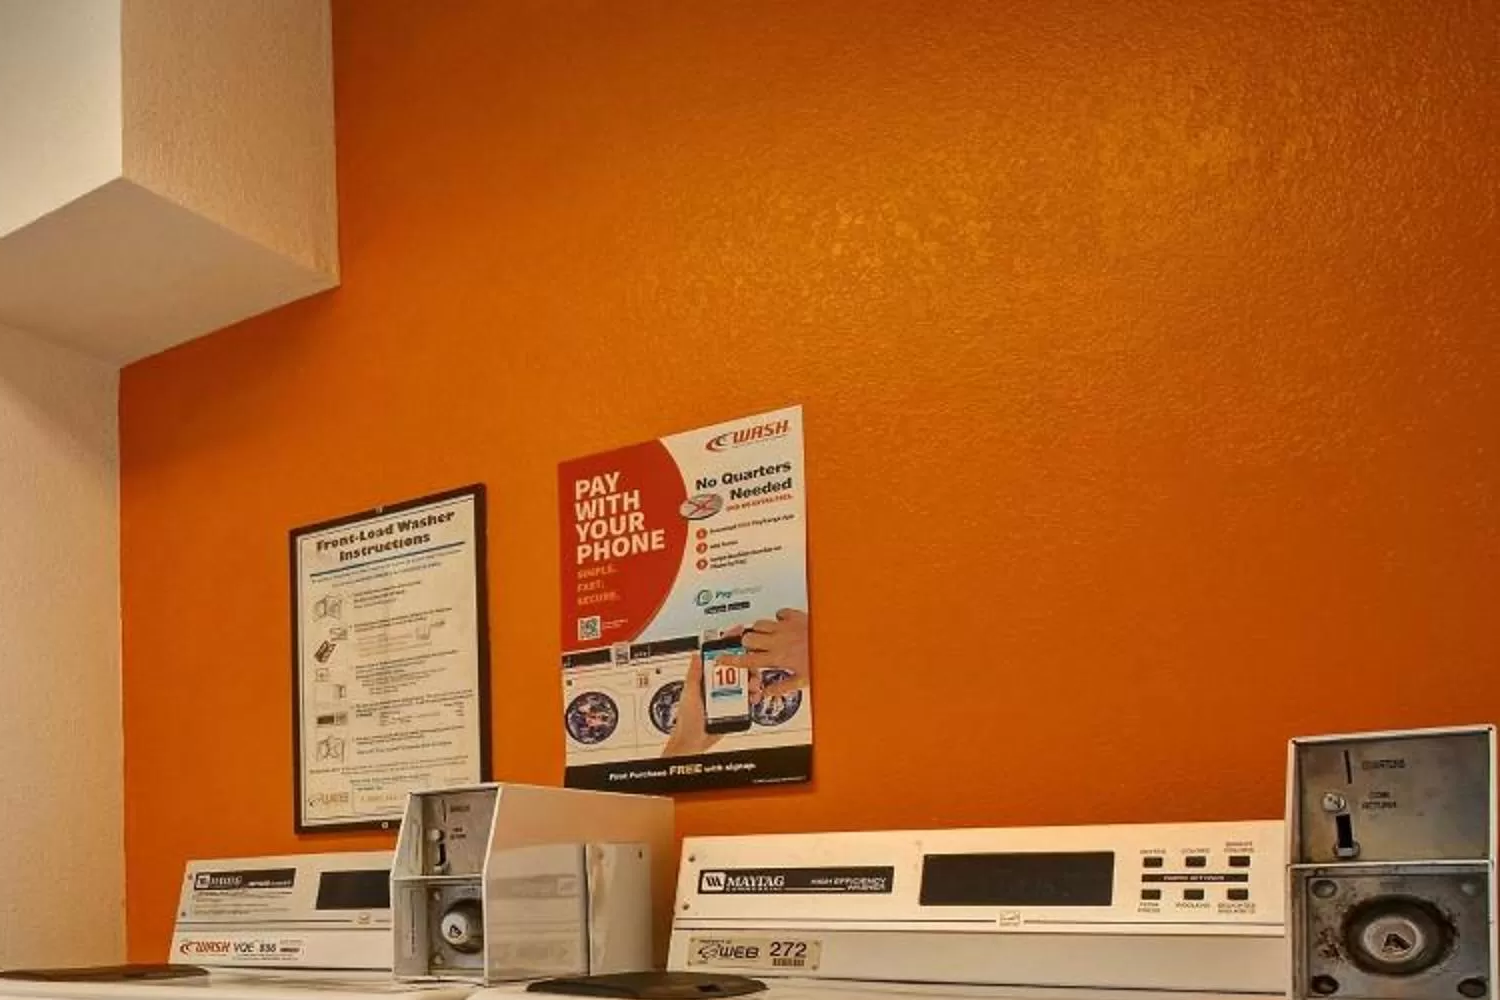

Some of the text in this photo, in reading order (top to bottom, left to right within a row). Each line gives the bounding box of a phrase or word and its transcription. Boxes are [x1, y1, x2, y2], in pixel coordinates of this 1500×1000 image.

[733, 420, 789, 443] WASH
[575, 472, 620, 500] PAY
[696, 462, 791, 491] No Quarters
[730, 477, 792, 500] Needed
[575, 490, 640, 521] WITH
[316, 511, 455, 552] Front-Load Washer
[576, 511, 645, 542] YOUR
[340, 533, 431, 562] Instructions
[577, 528, 665, 565] PHONE
[715, 667, 737, 686] 10
[609, 772, 627, 782] First
[629, 769, 666, 780] Purchase
[669, 763, 703, 776] FREE
[704, 763, 723, 773] with
[726, 875, 785, 887] MAYTAG
[834, 877, 887, 886] EFFICIENCY
[195, 941, 231, 953] WASH
[719, 941, 807, 959] WEB 272
